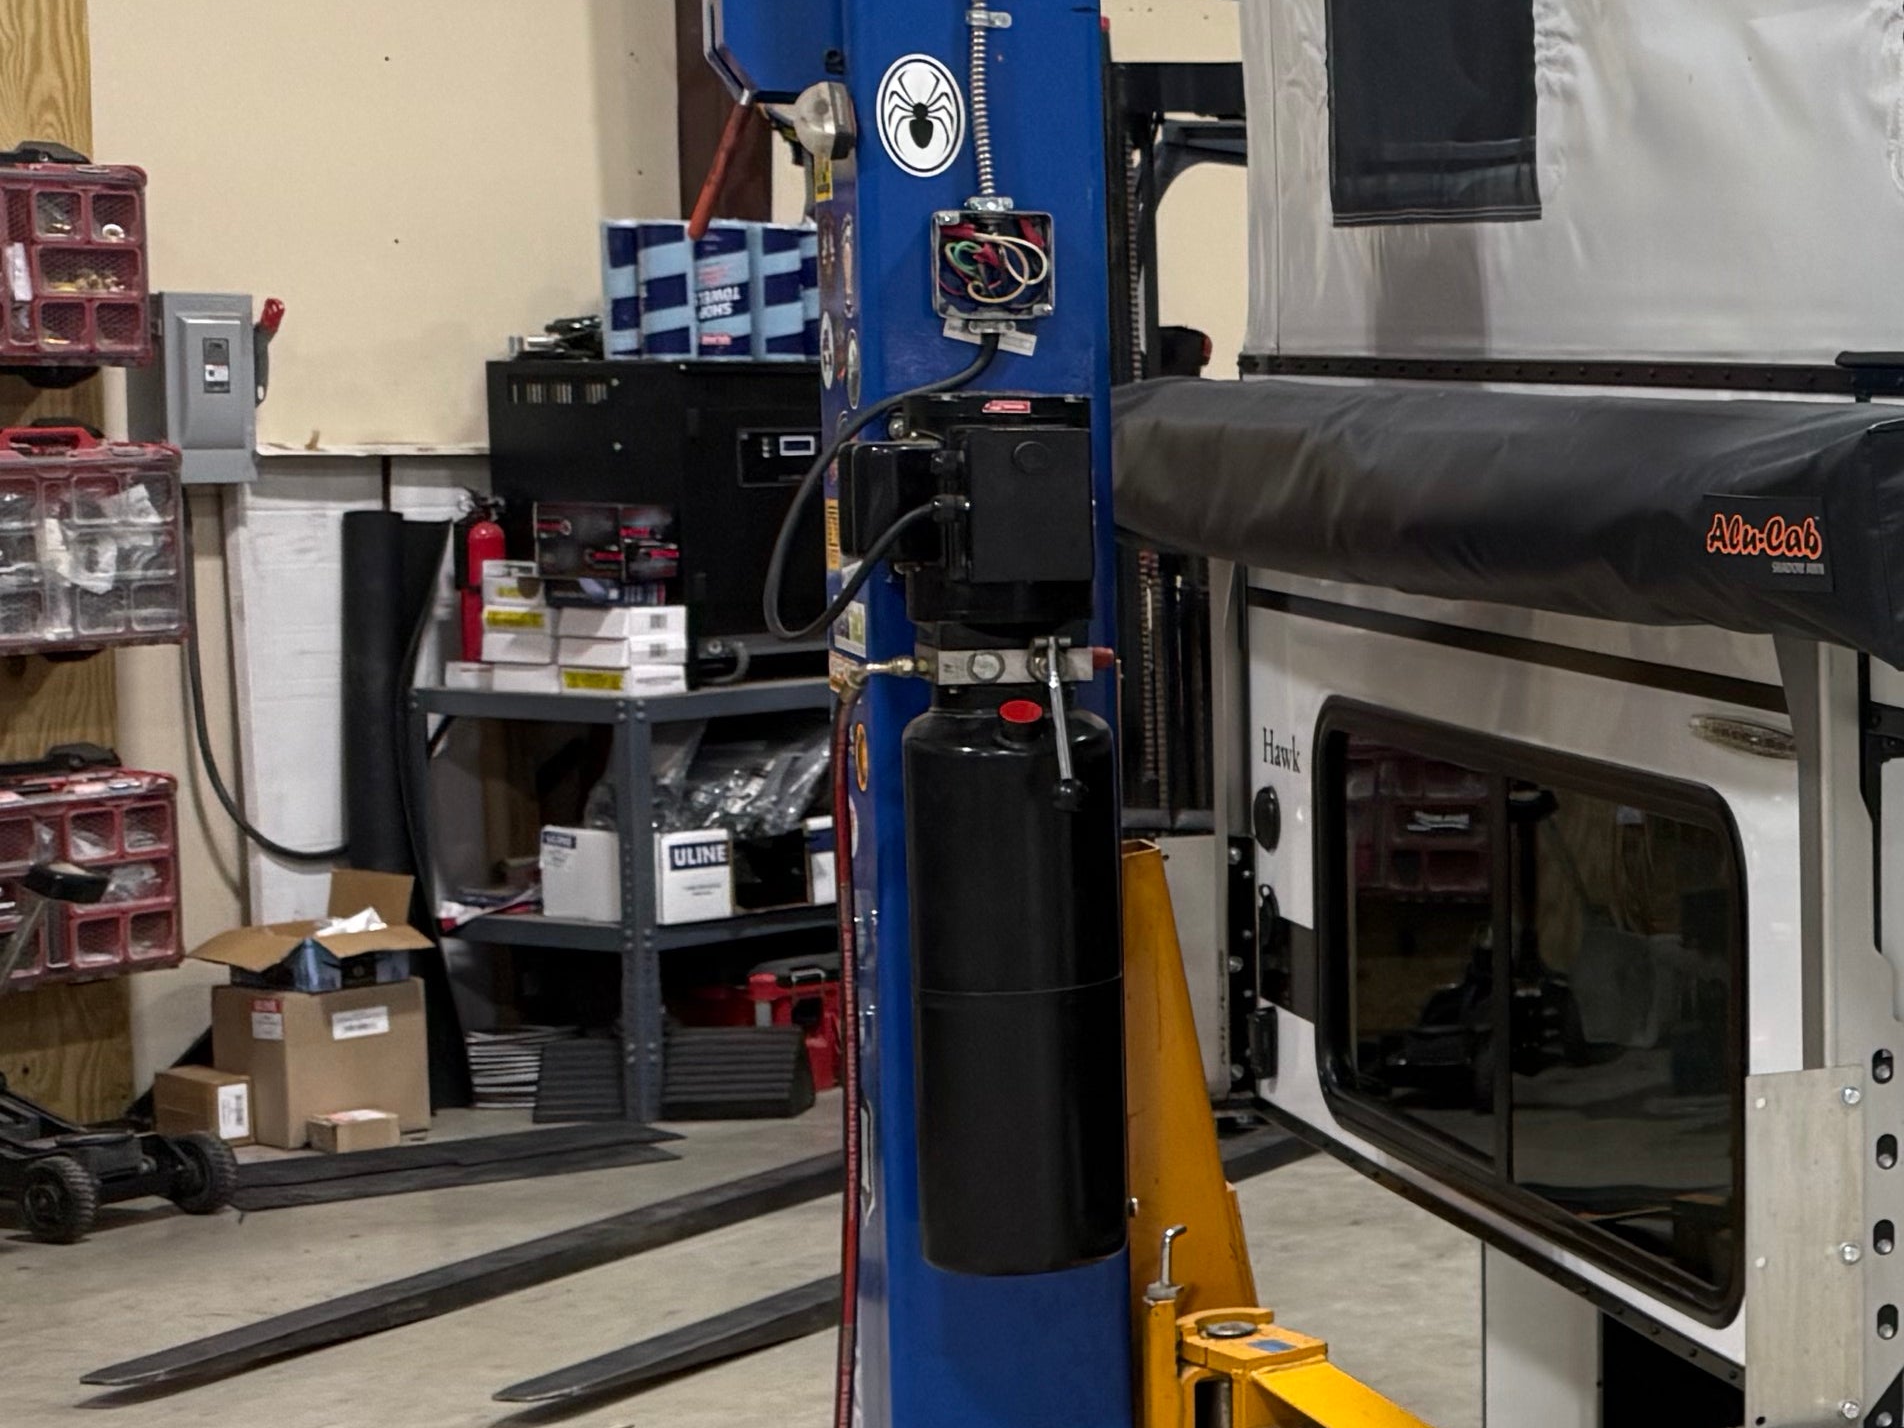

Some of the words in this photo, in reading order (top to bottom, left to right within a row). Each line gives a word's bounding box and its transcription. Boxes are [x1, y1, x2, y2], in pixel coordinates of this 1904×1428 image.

[1706, 513, 1823, 560] Alu-Cab
[1263, 726, 1301, 773] Hawk
[674, 845, 727, 867] ULINE
